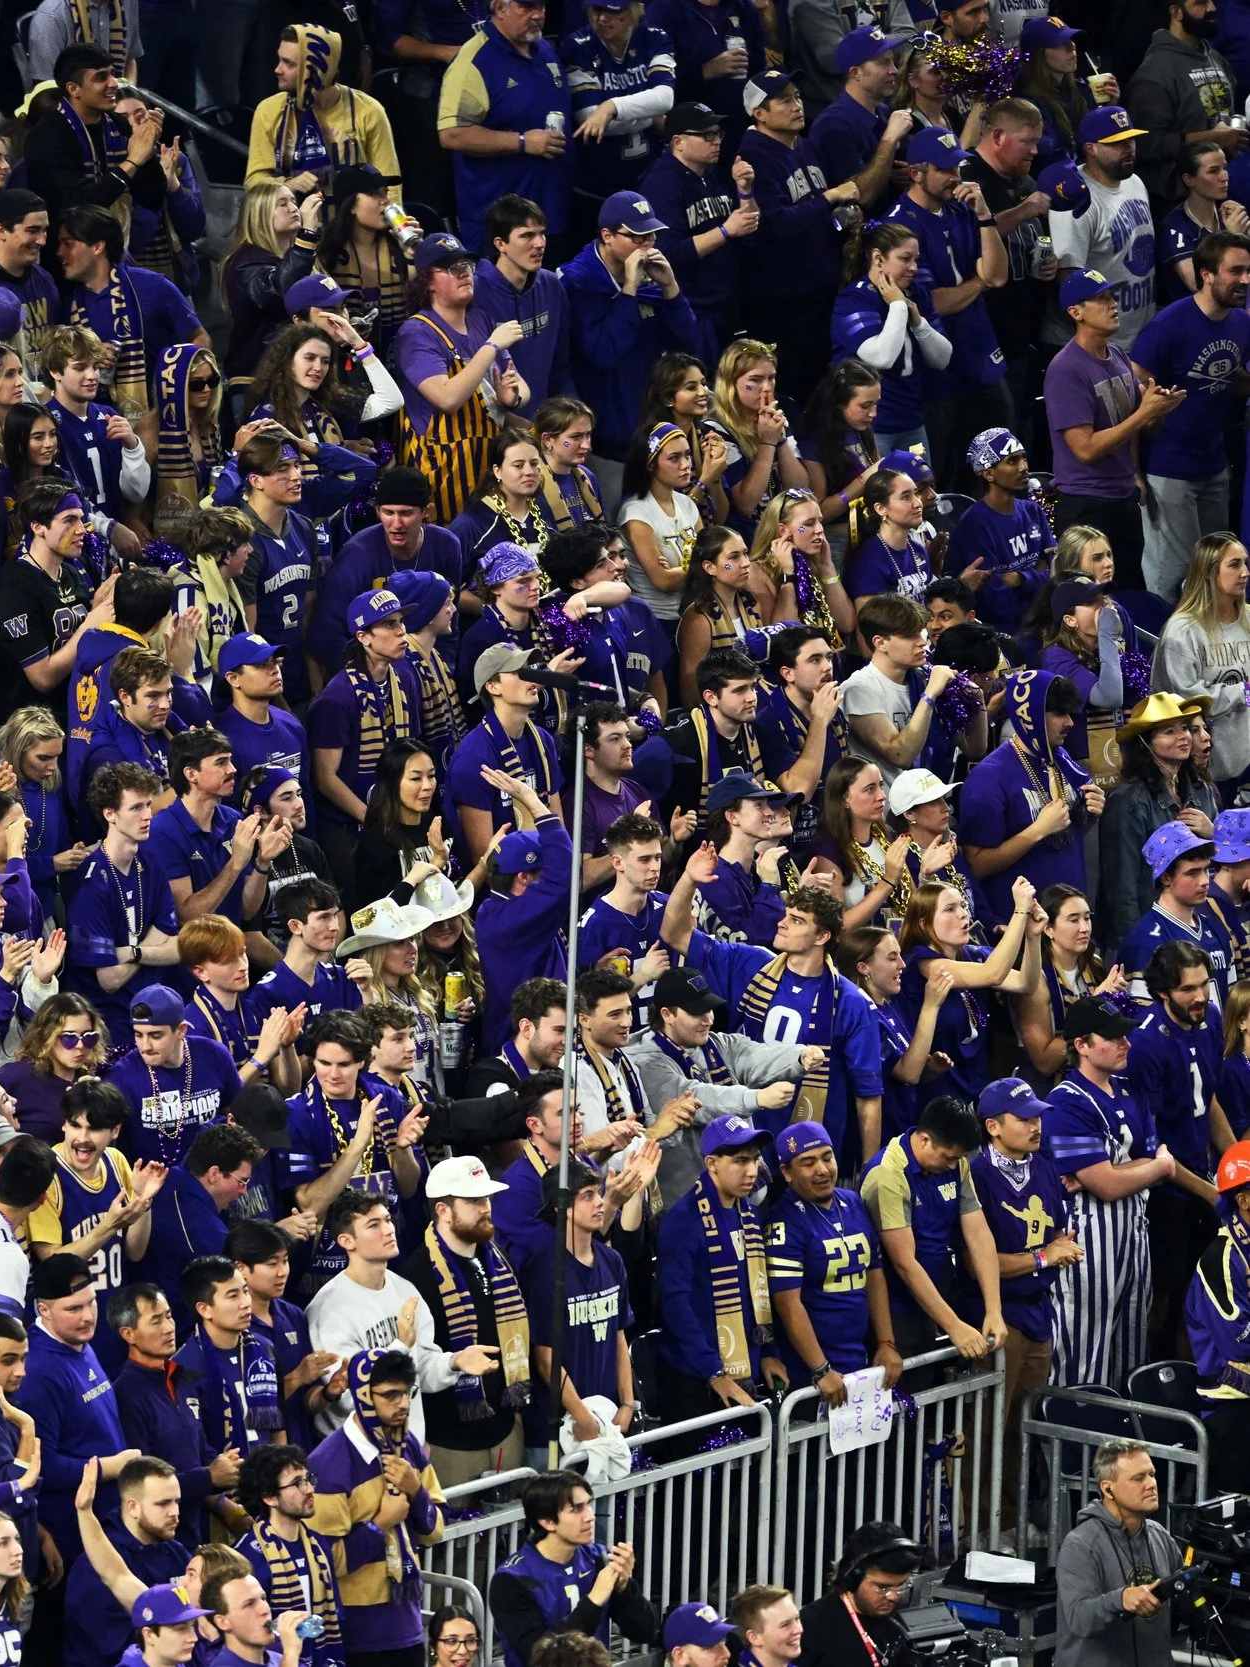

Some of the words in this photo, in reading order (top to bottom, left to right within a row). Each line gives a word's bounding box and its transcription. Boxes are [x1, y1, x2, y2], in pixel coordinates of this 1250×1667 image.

[937, 133, 958, 149] W
[1213, 362, 1228, 374] 36
[84, 432, 94, 441] W
[87, 447, 106, 504] 1
[1009, 533, 1029, 557] W
[283, 594, 300, 630] 2
[3, 612, 29, 639] W
[1199, 640, 1250, 668] ASHINGT
[1012, 668, 1039, 736] TACO
[1095, 776, 1119, 786] PLA
[638, 940, 649, 951] W
[310, 1003, 322, 1016] W
[1190, 1061, 1207, 1118] 1
[937, 1181, 957, 1202] W
[1031, 1219, 1040, 1235] 9
[88, 1243, 123, 1289] 20
[822, 1232, 871, 1294] 23
[284, 1331, 299, 1346] W
[591, 1321, 609, 1343] W
[170, 1585, 191, 1606] W
